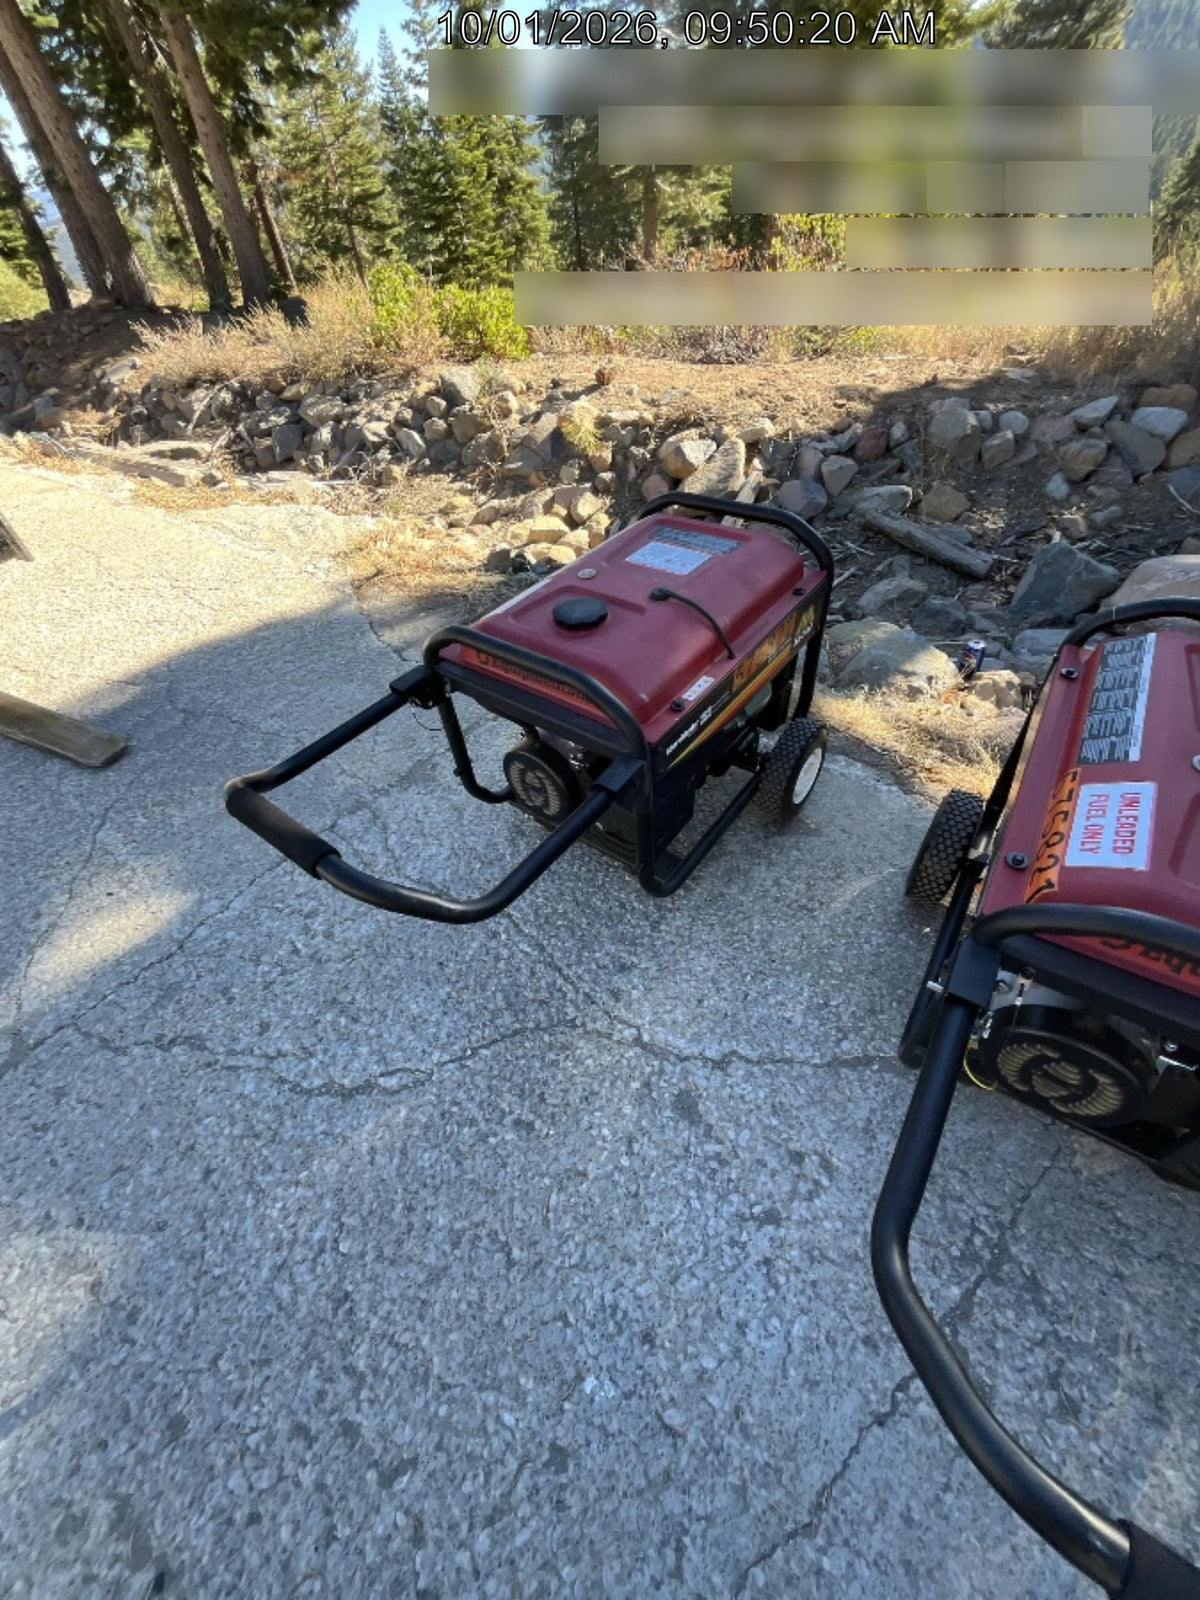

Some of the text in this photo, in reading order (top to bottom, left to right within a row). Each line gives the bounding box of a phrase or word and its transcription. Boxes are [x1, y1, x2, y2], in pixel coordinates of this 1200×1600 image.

[1079, 793, 1110, 855] FUEL ONLY
[1111, 791, 1143, 855] UNLEADED
